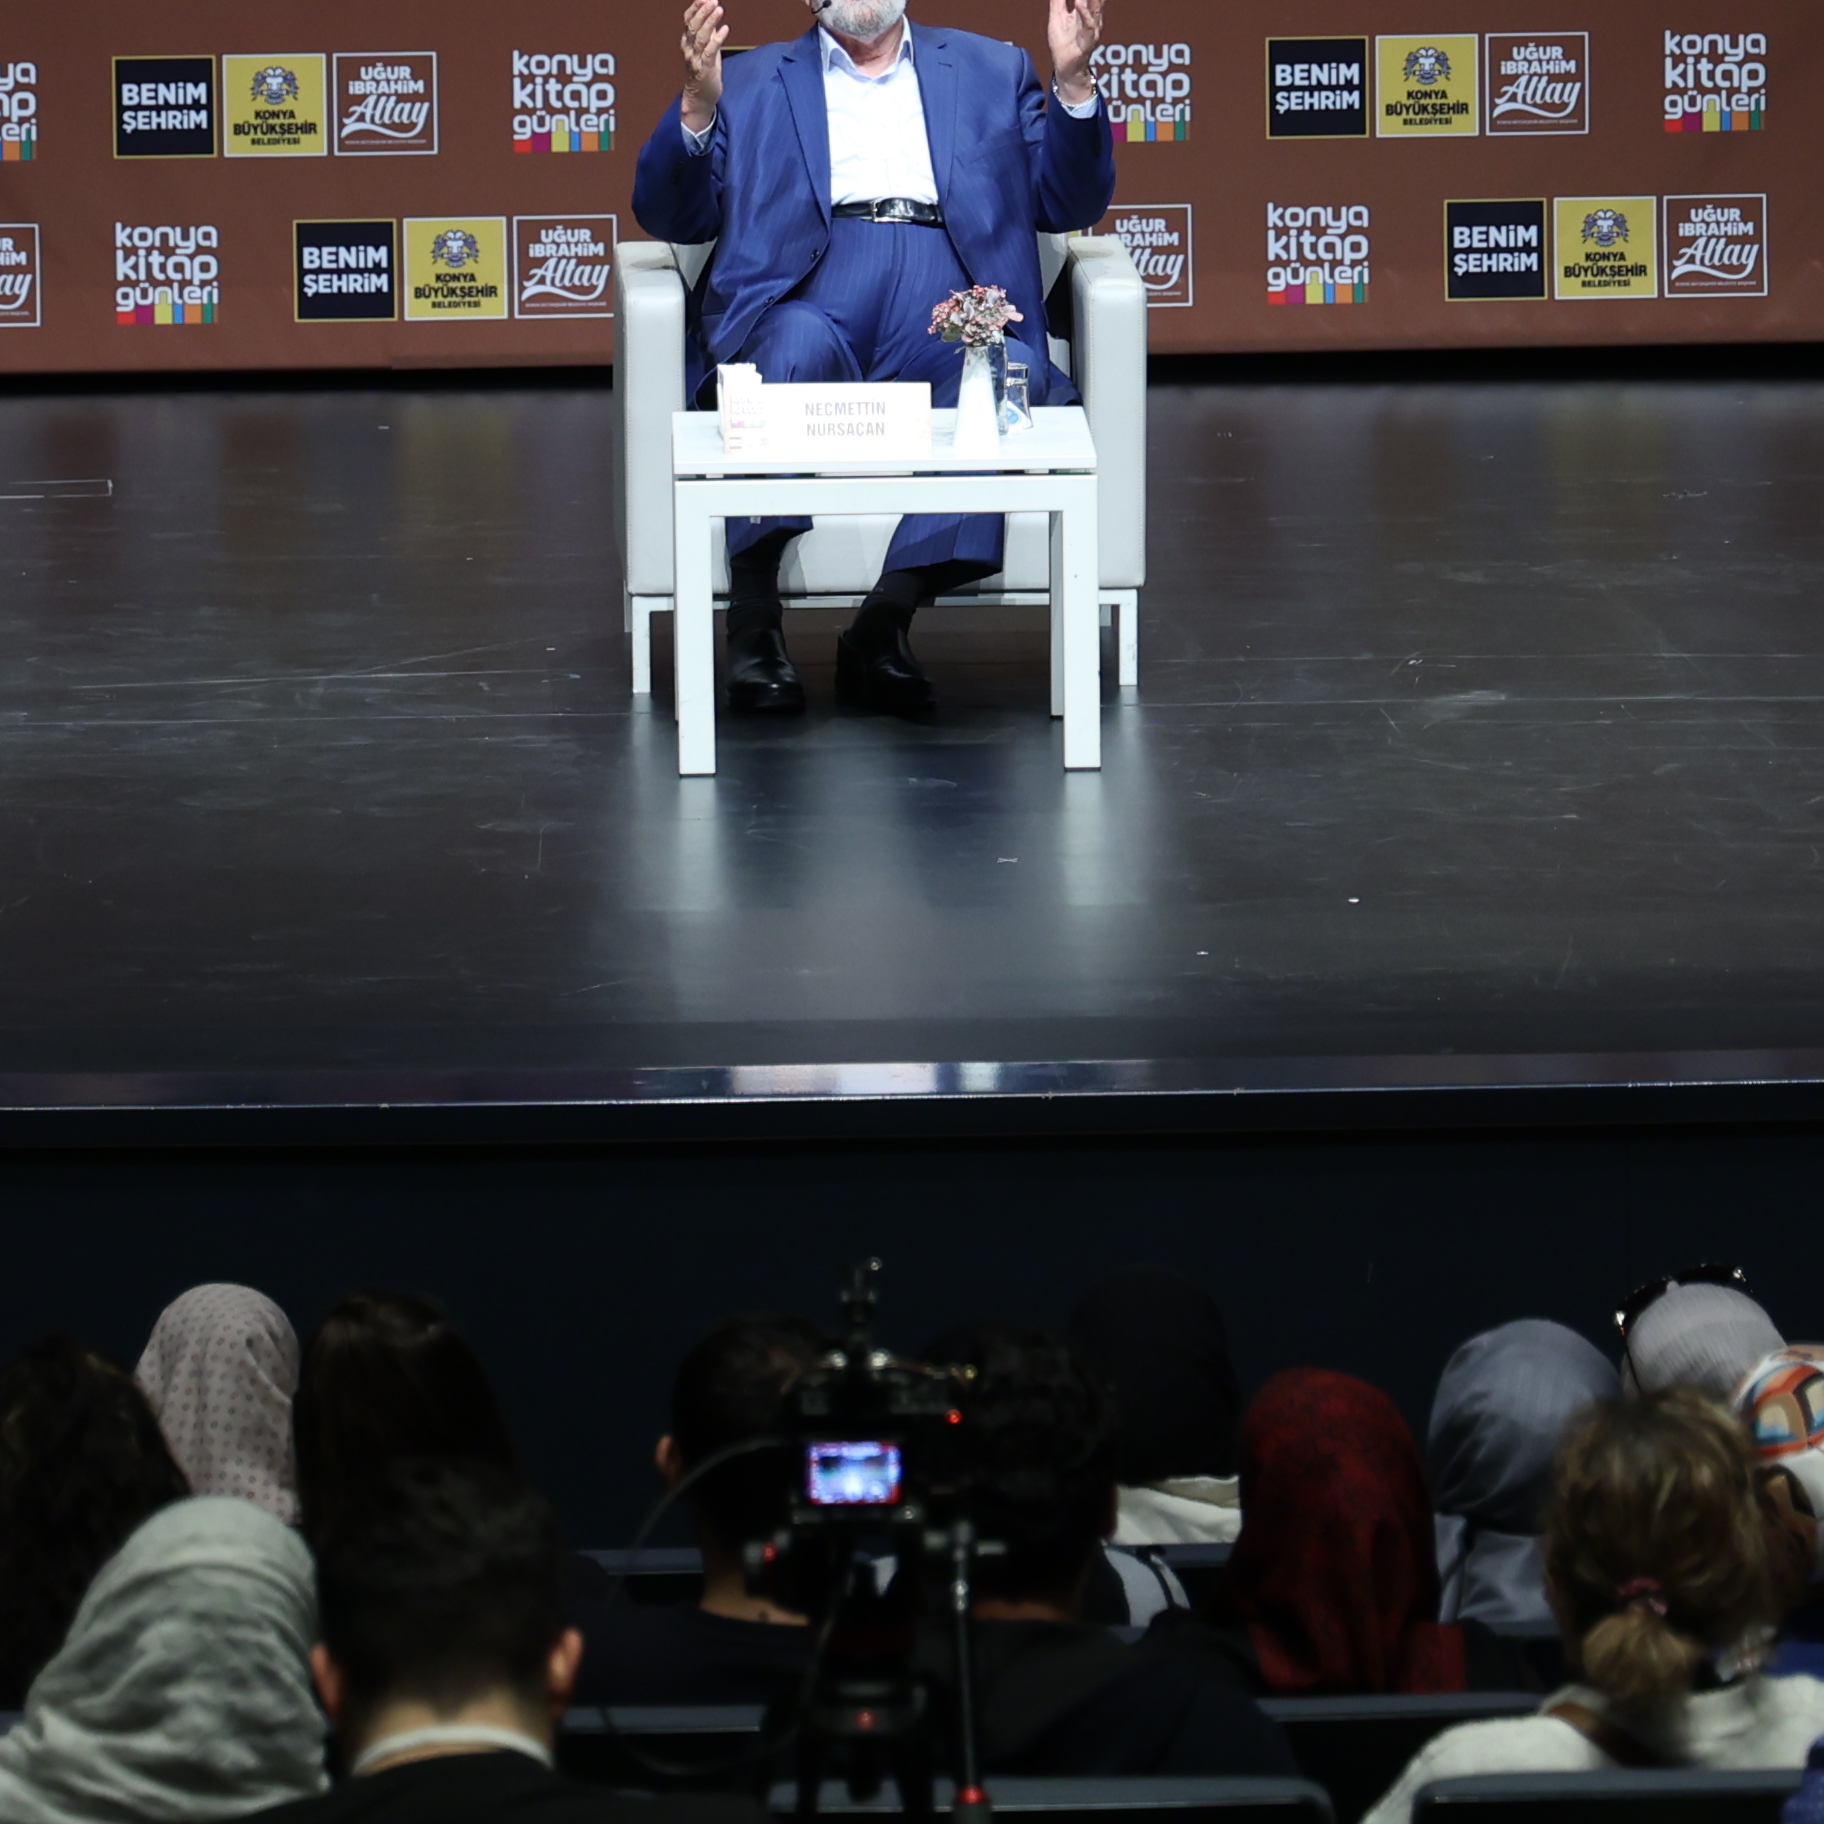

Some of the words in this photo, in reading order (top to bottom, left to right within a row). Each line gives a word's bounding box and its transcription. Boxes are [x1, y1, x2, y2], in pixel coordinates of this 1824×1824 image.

[1664, 30, 1766, 62] konya
[360, 62, 412, 80] UĞUR
[1664, 56, 1766, 94] kitap
[254, 110, 296, 121] KONYA
[341, 94, 430, 138] Altay
[1107, 99, 1191, 123] ünleri
[1664, 89, 1765, 120] günleri
[1115, 215, 1166, 233] UĞUR
[1267, 202, 1370, 234] konya
[1690, 204, 1741, 222] UĞUR
[1267, 228, 1370, 266] kitap
[1585, 252, 1626, 263] KONYA
[1671, 236, 1760, 280] Altay
[1267, 261, 1370, 292] günleri
[805, 399, 885, 415] NECMETTİN
[806, 422, 885, 438] NURSAÇAN
